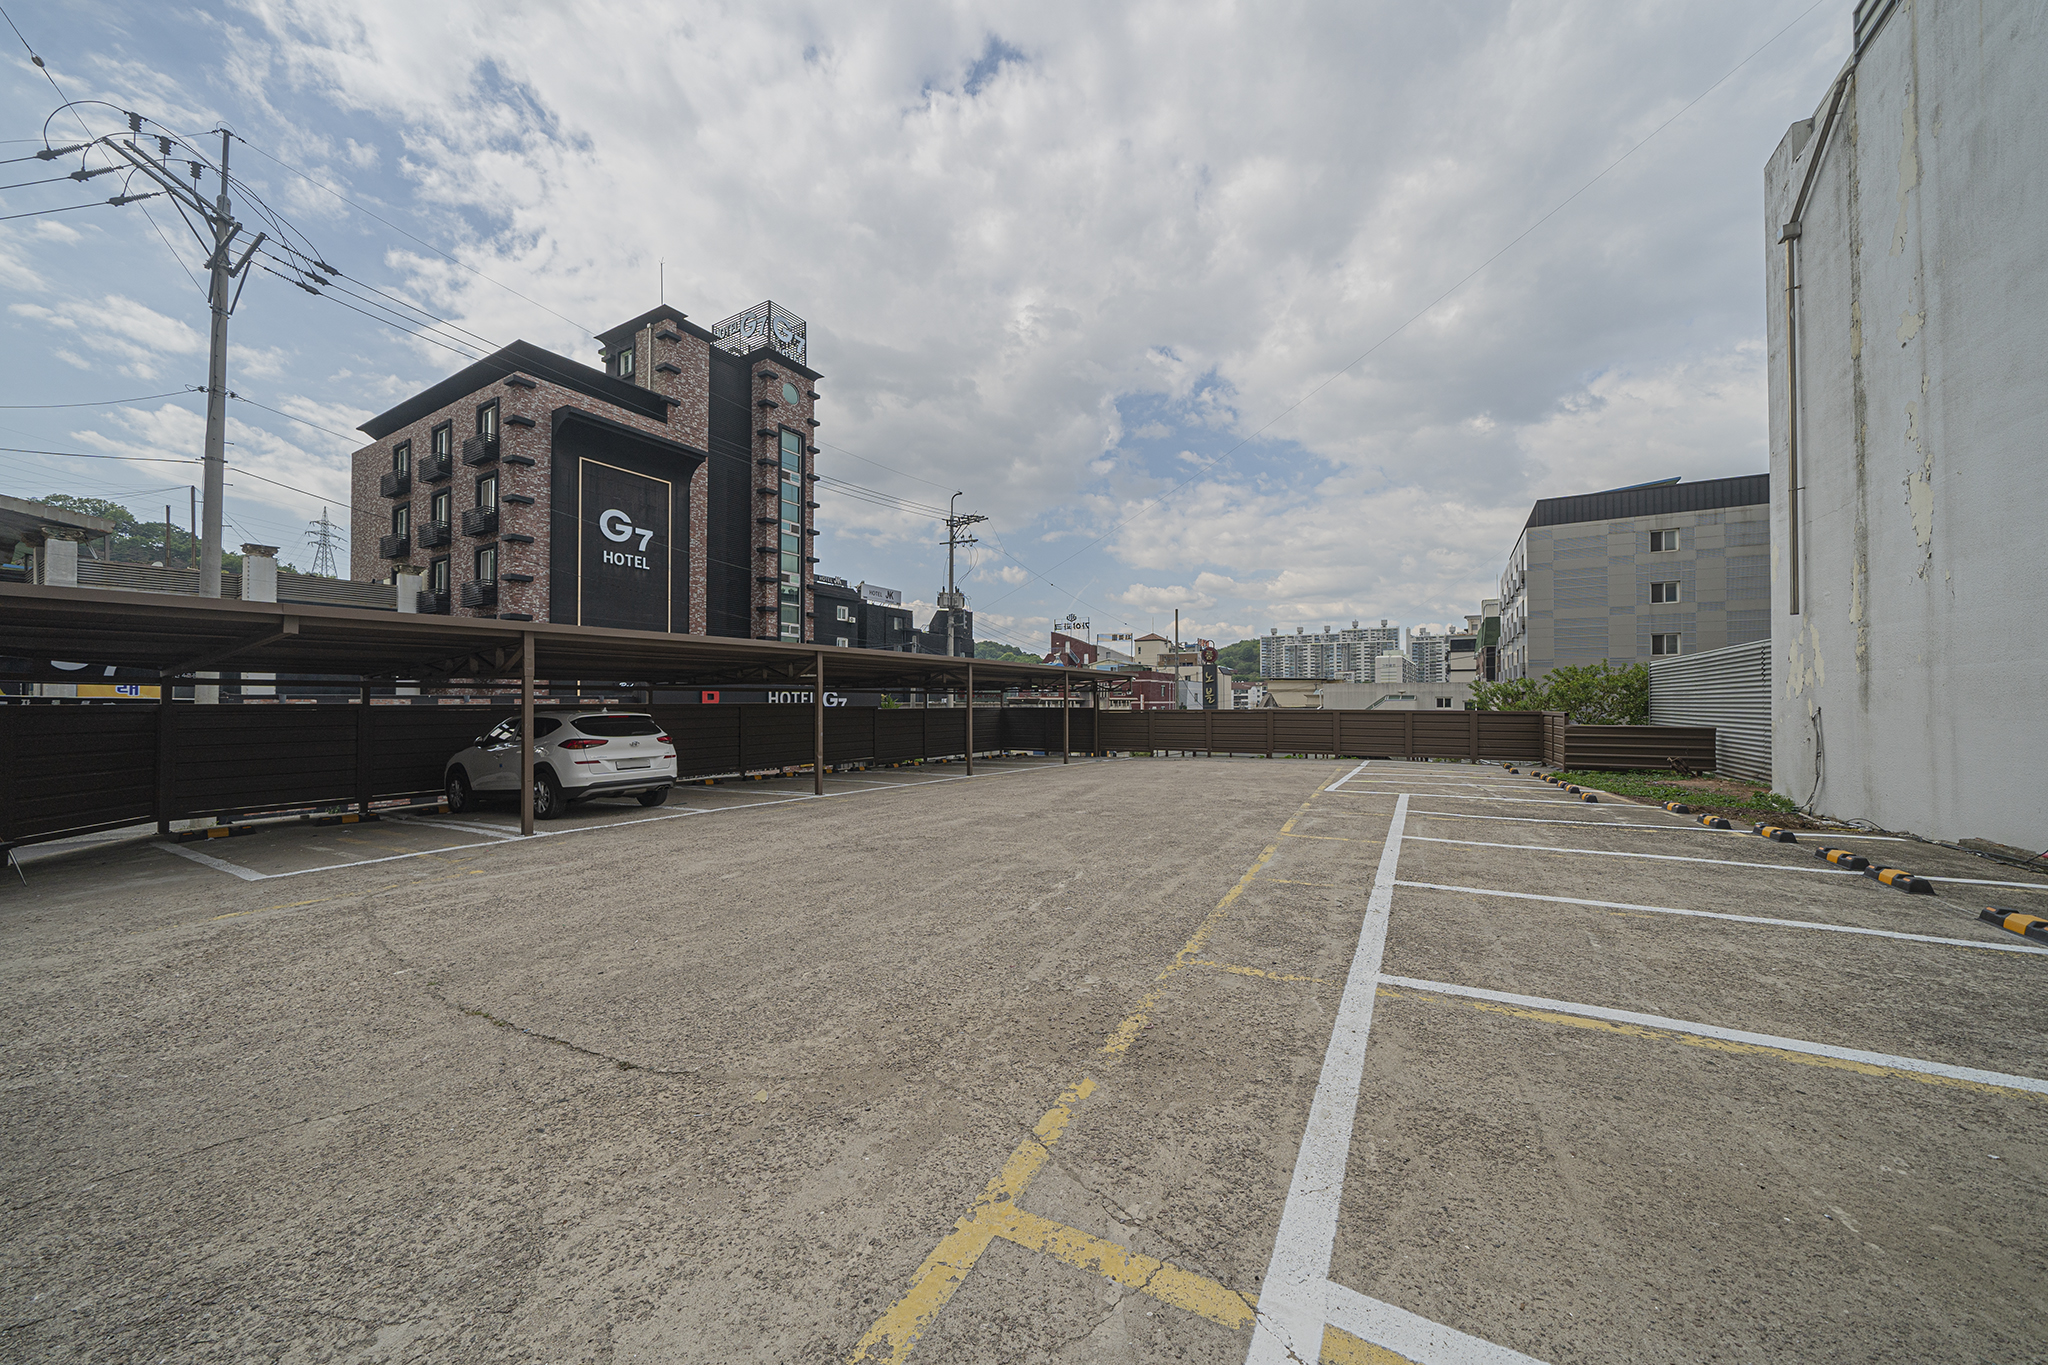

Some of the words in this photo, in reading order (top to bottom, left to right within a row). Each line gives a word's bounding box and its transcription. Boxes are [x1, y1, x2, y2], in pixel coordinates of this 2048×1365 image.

[714, 321, 740, 338] HOTEL
[740, 311, 768, 338] G7
[773, 316, 806, 353] G7
[599, 509, 654, 552] G7
[603, 550, 650, 570] HOTEL
[818, 575, 833, 583] HOTEL
[868, 589, 883, 598] HOTEL
[822, 691, 848, 707] G7
[1204, 671, 1215, 704] 노블
